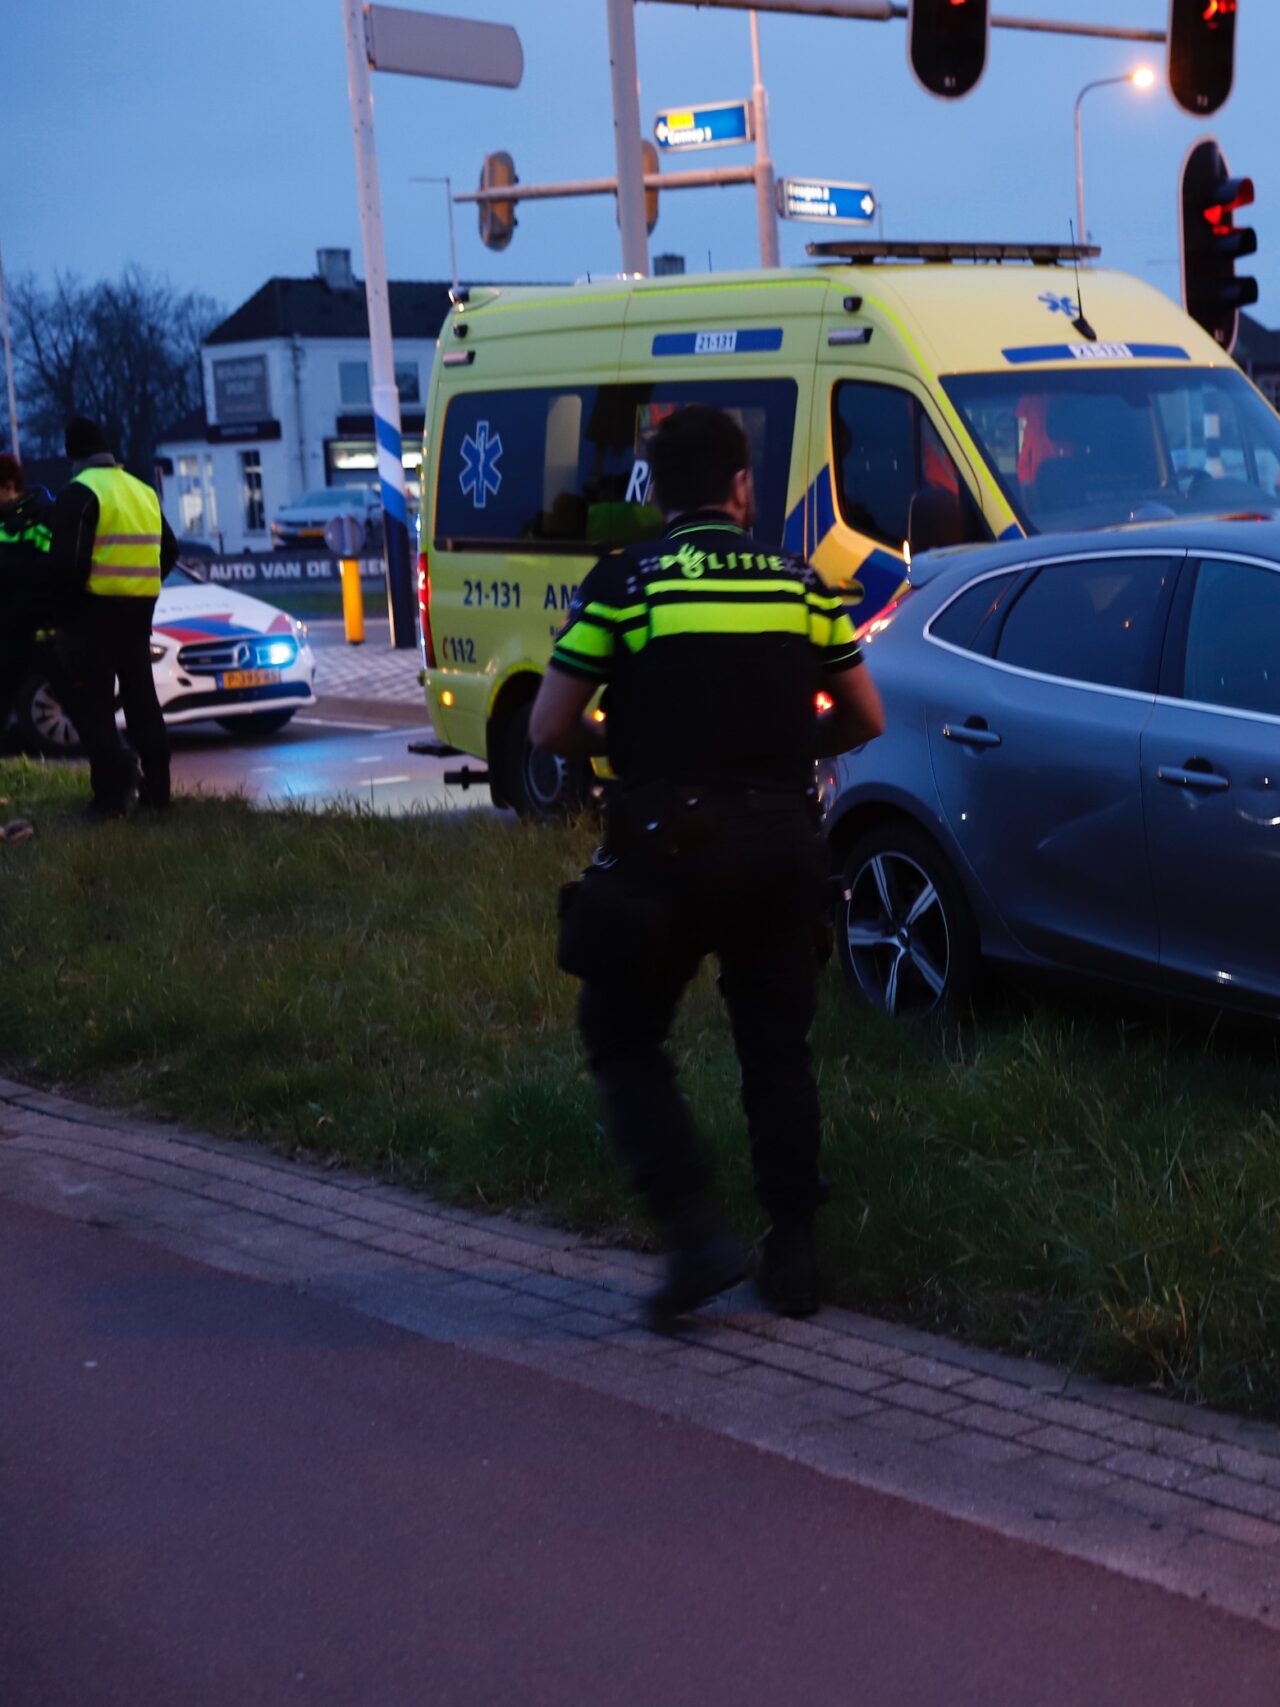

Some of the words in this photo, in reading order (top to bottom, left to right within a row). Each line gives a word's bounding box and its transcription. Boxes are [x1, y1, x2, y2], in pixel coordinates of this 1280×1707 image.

[698, 335, 734, 351] 21-131
[210, 563, 256, 581] AUTO
[261, 562, 301, 578] VAN
[306, 560, 332, 577] DE
[463, 580, 521, 608] 21-131
[449, 637, 476, 664] 112
